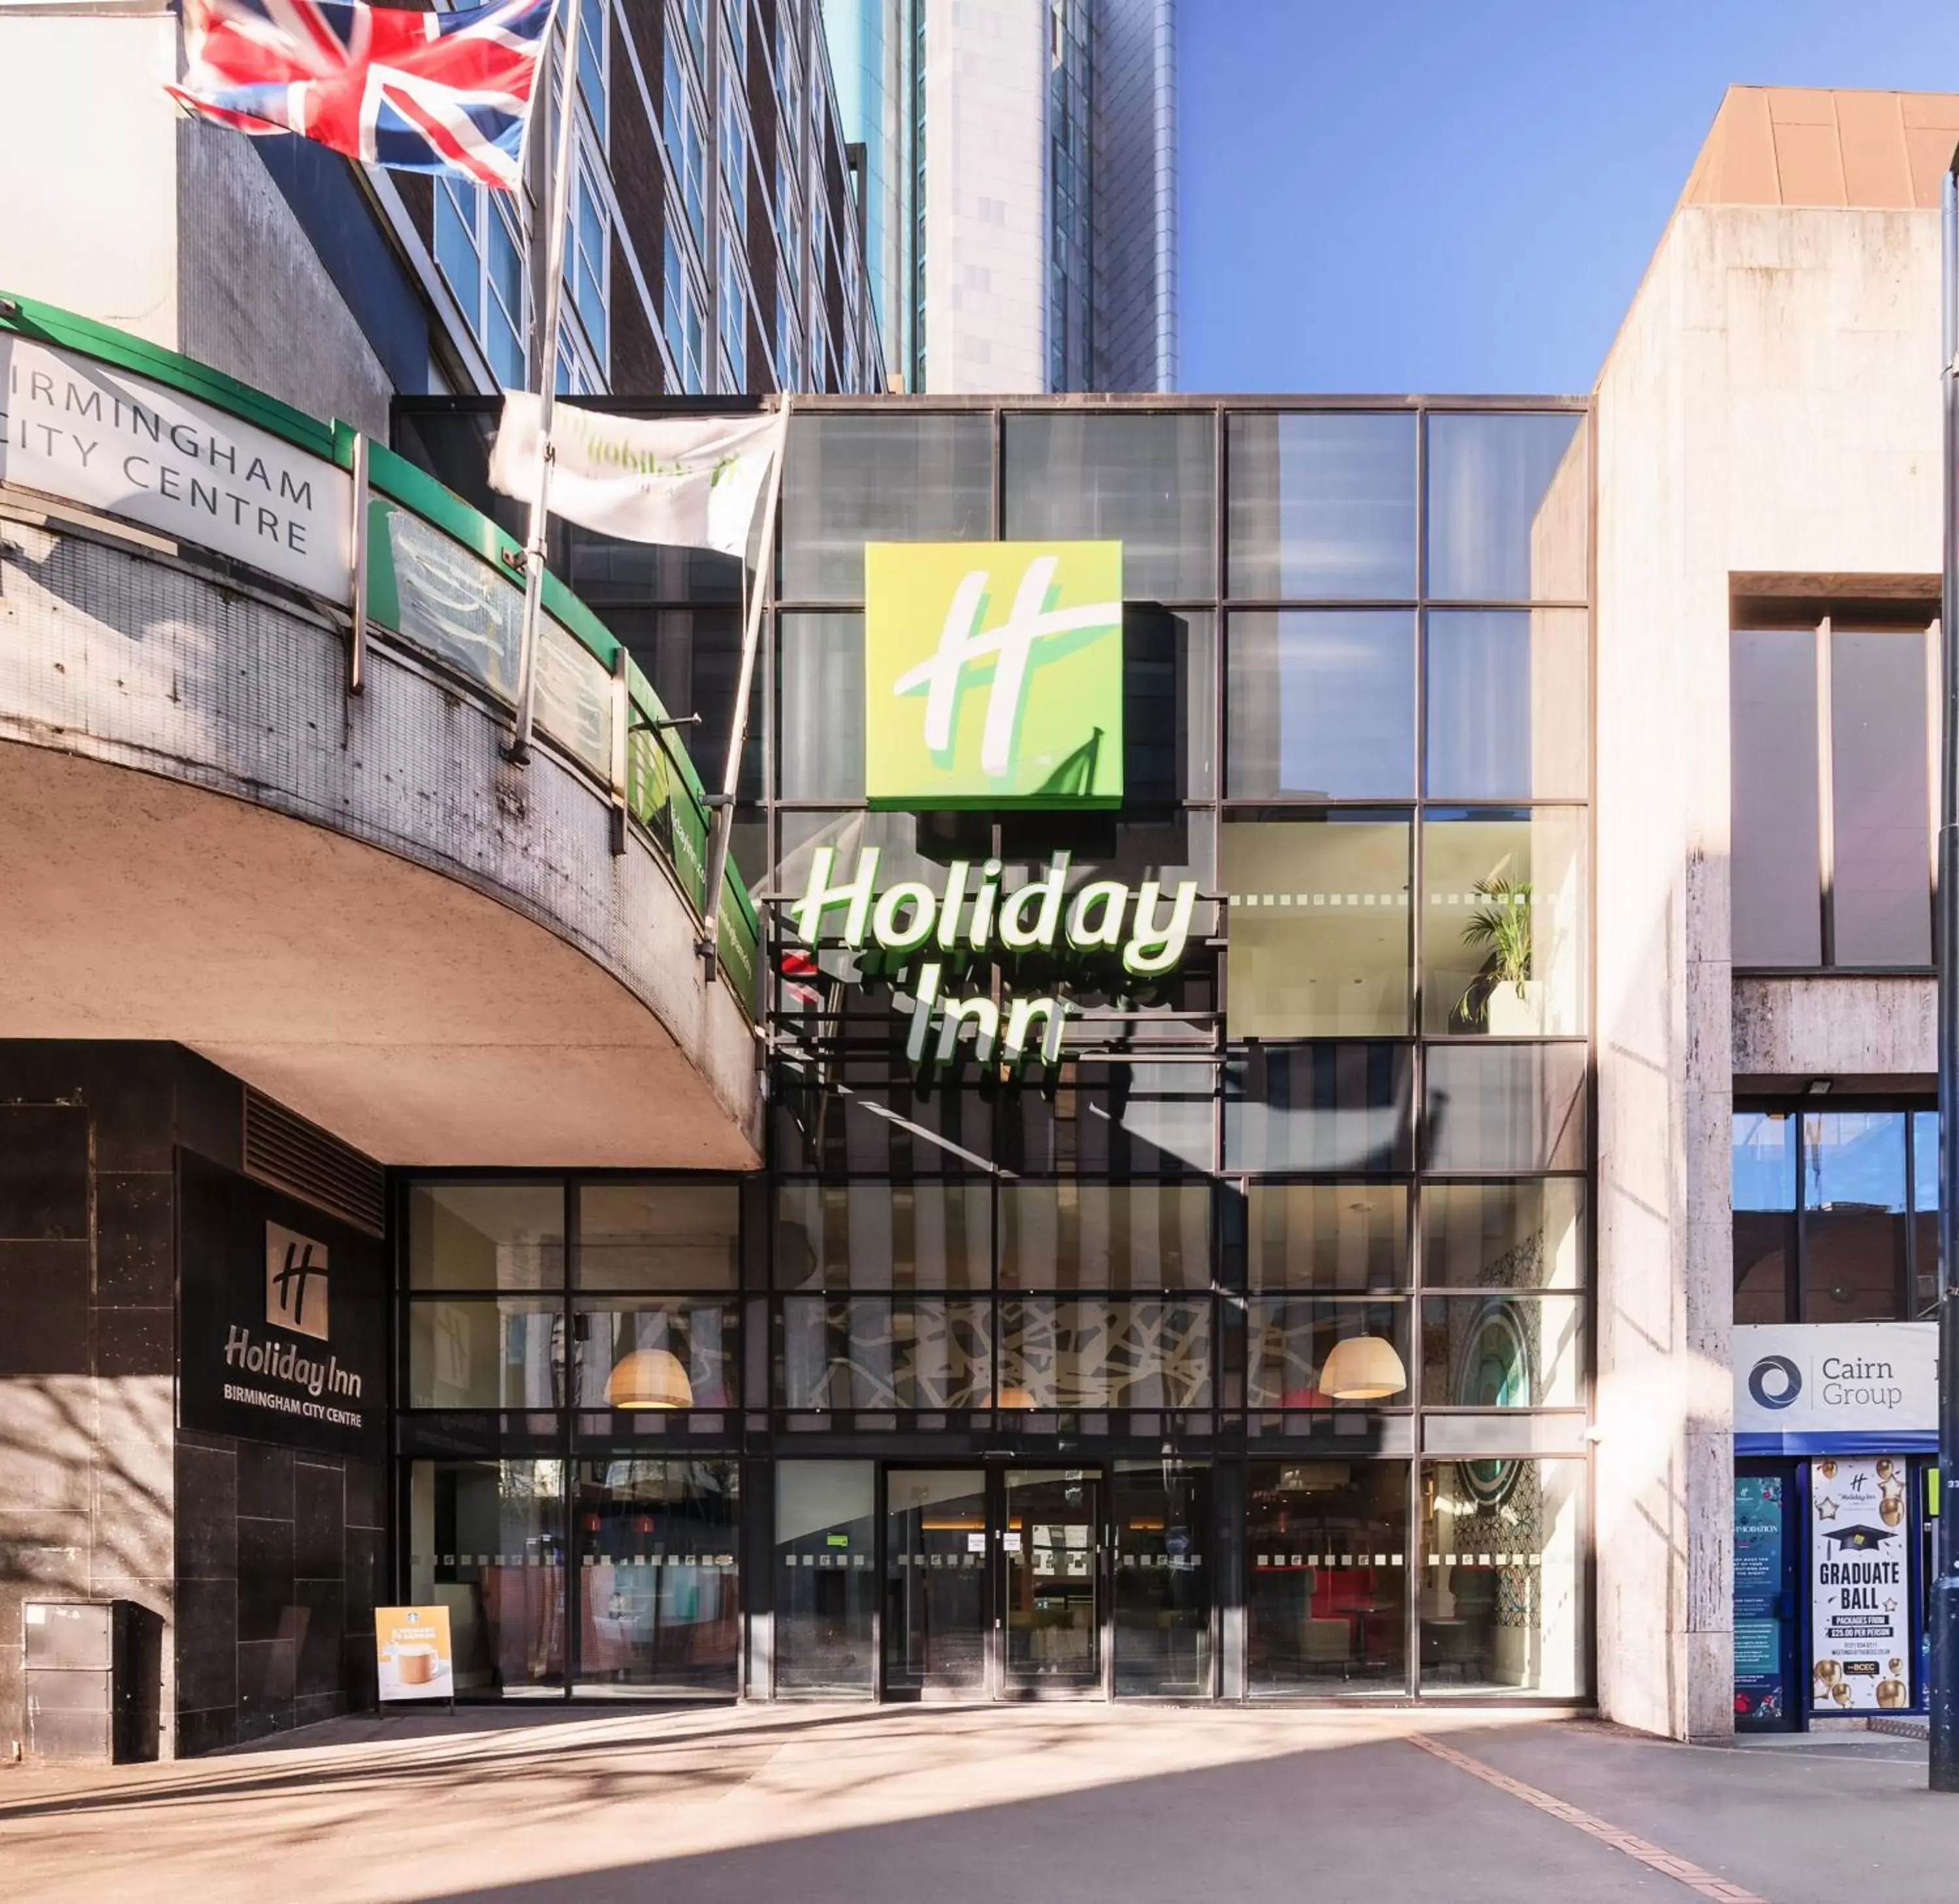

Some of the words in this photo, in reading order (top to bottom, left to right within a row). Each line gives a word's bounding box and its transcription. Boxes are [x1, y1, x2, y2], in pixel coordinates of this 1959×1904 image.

[123, 456, 307, 555] CENTRE
[791, 847, 1198, 977] Holiday
[906, 963, 1067, 1067] Inn
[224, 1324, 325, 1397] Holiday
[328, 1356, 362, 1399] Inn
[1822, 1357, 1894, 1380] Cairn
[223, 1384, 301, 1415] BIRMINGHAM
[302, 1402, 325, 1420] CITY
[327, 1407, 362, 1428] CENTRE
[1822, 1382, 1903, 1410] Group
[1819, 1562, 1900, 1585] GRADUATE
[1841, 1587, 1879, 1610] BALL
